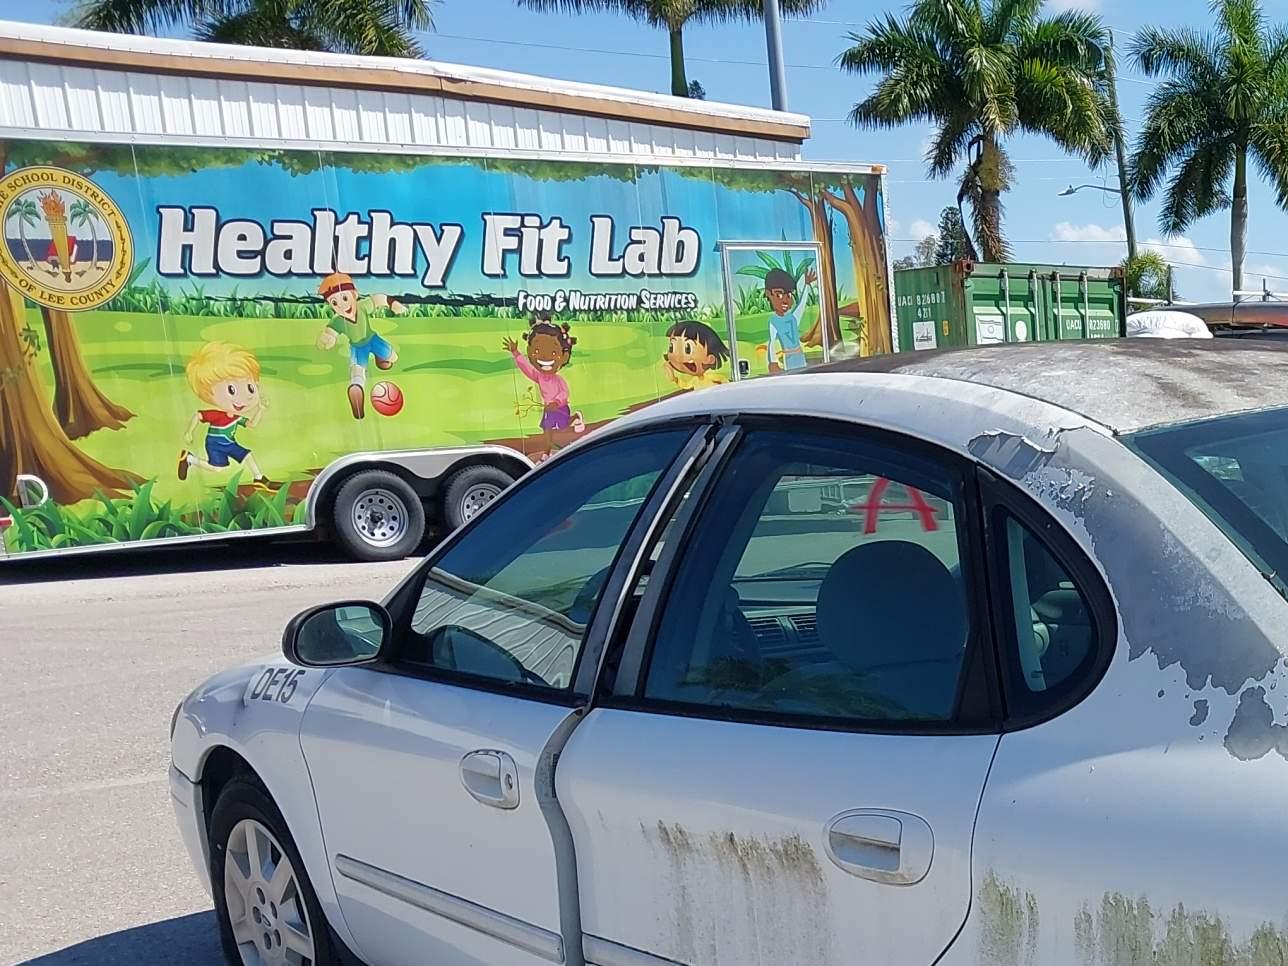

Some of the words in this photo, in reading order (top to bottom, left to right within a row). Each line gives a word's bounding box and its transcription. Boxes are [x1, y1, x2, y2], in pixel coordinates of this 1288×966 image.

[7, 172, 58, 192] SCHOOL
[62, 176, 116, 218] DISTRICT
[157, 206, 464, 288] Healthy
[483, 213, 571, 276] Fit
[589, 214, 700, 276] Lab
[19, 278, 37, 295] OF
[39, 290, 65, 306] LEE
[70, 279, 117, 306] COUNTY
[554, 290, 567, 312] &
[250, 667, 306, 703] DE15
